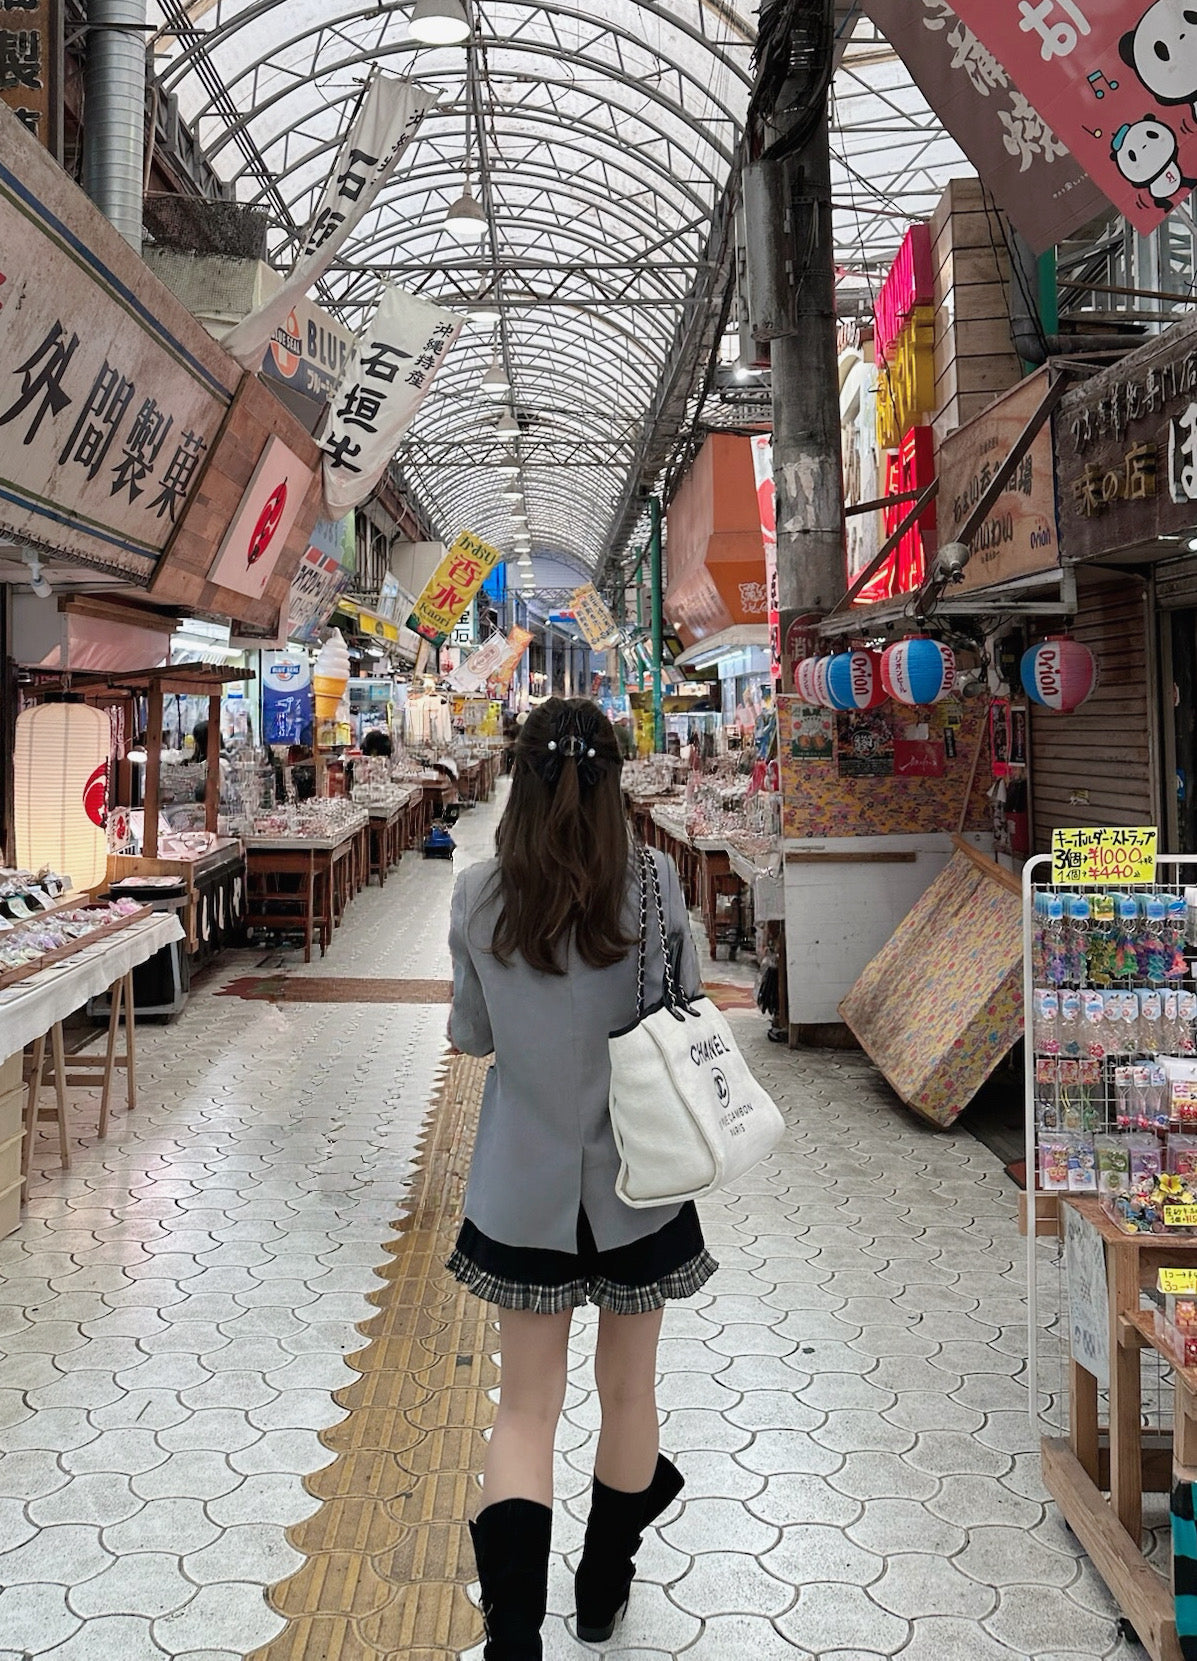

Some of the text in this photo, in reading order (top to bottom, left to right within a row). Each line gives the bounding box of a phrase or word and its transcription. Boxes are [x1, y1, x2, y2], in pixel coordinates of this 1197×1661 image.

[287, 335, 300, 355] SEAL
[308, 319, 346, 377] BLUE
[404, 321, 454, 390] 沖縄特産
[0, 319, 208, 522] 外間製菓
[326, 341, 414, 474] 石垣牛
[1072, 442, 1157, 517] 味の店
[459, 536, 497, 566] かおり
[420, 602, 452, 627] Kaori
[427, 553, 483, 616] 香水
[690, 1033, 731, 1067] CHANEL
